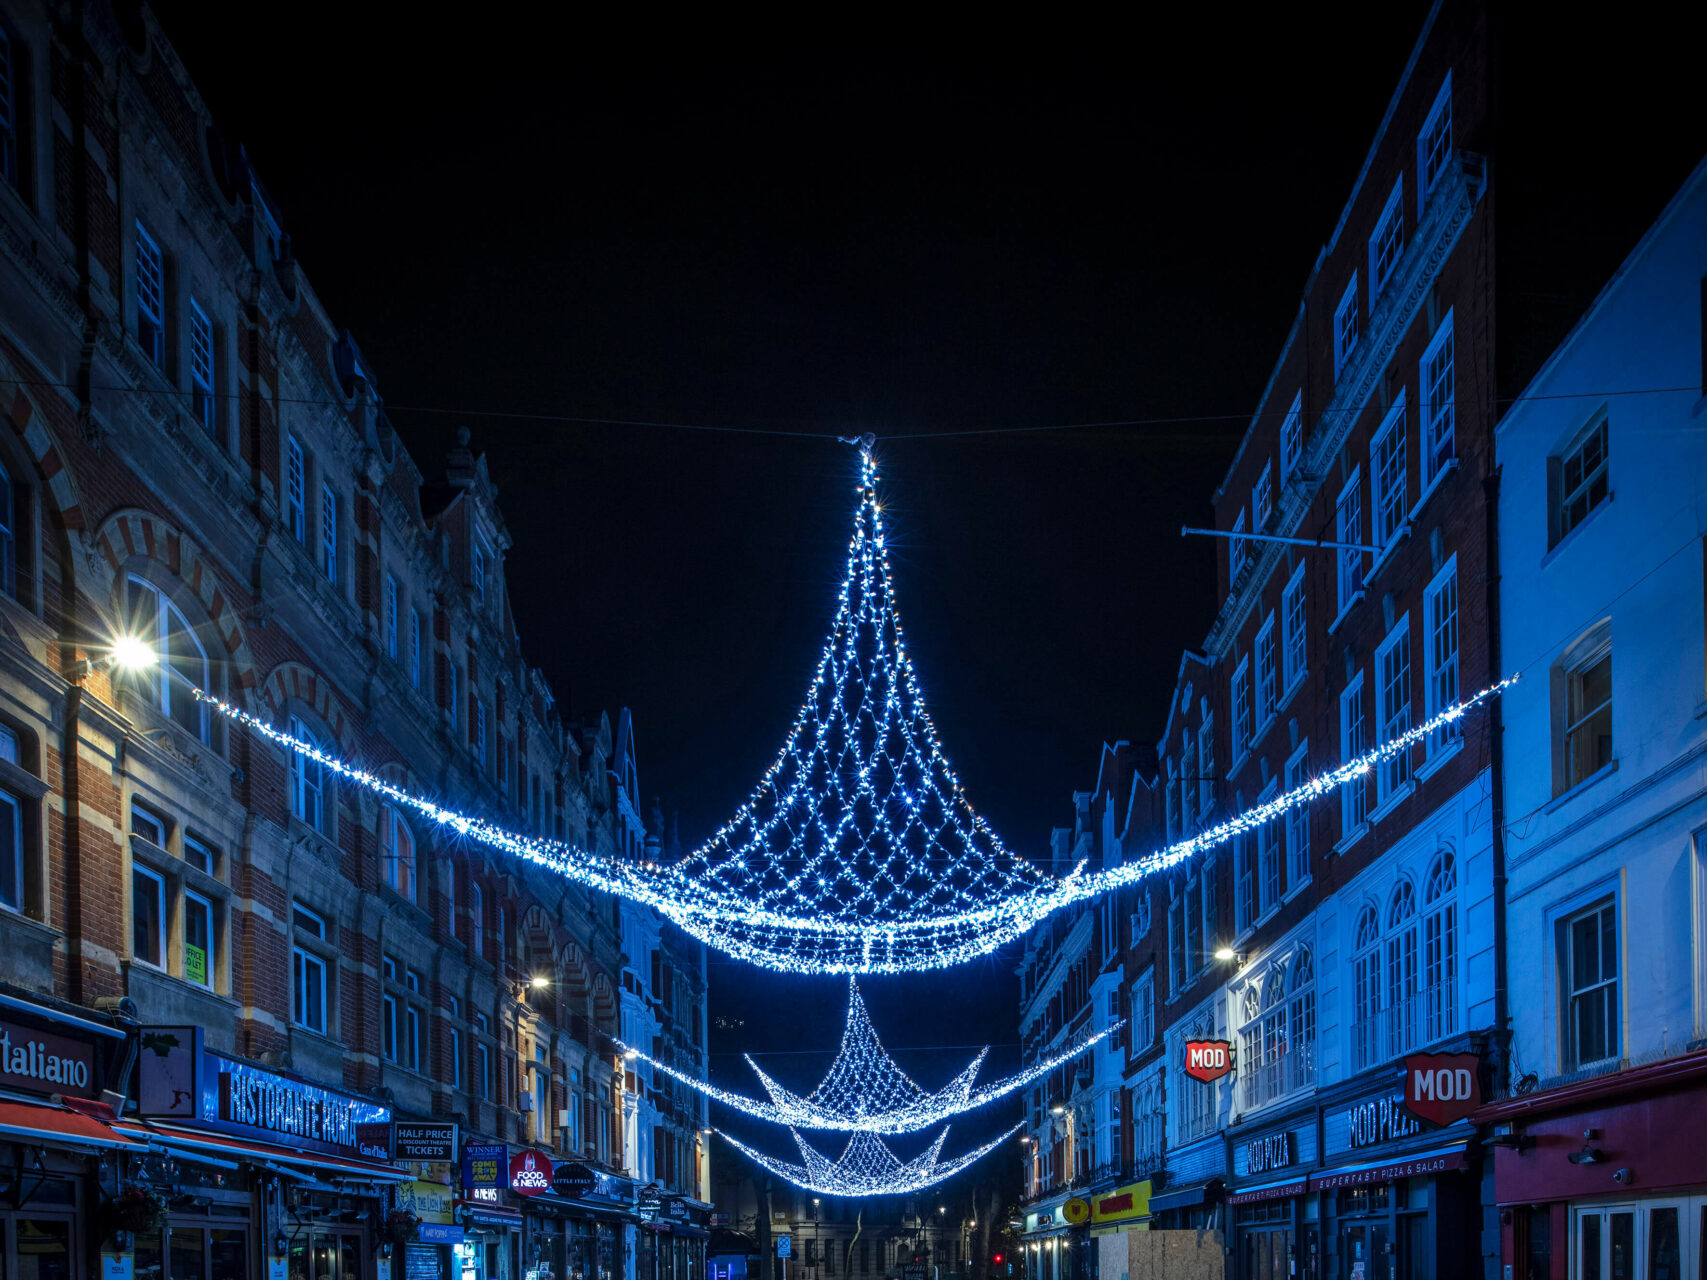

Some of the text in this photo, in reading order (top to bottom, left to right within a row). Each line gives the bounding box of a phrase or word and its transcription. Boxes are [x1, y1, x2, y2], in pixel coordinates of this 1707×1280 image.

[0, 1026, 88, 1088] taliano
[1191, 1048, 1225, 1069] MOD
[1414, 1068, 1472, 1101] MOD
[230, 1072, 357, 1148] RISTORANTE ROMA
[398, 1129, 453, 1139] HALF PRICE
[1348, 1102, 1376, 1149] MOD
[405, 1146, 444, 1155] TICKETS
[1247, 1131, 1289, 1175] MOD PIZZA
[472, 1160, 497, 1168] COME
[1319, 1159, 1445, 1189] SUPERFAST PIZZA & SALAD
[512, 1179, 548, 1187] & NEWS
[517, 1171, 544, 1180] FOOD
[480, 1188, 497, 1202] NEWS
